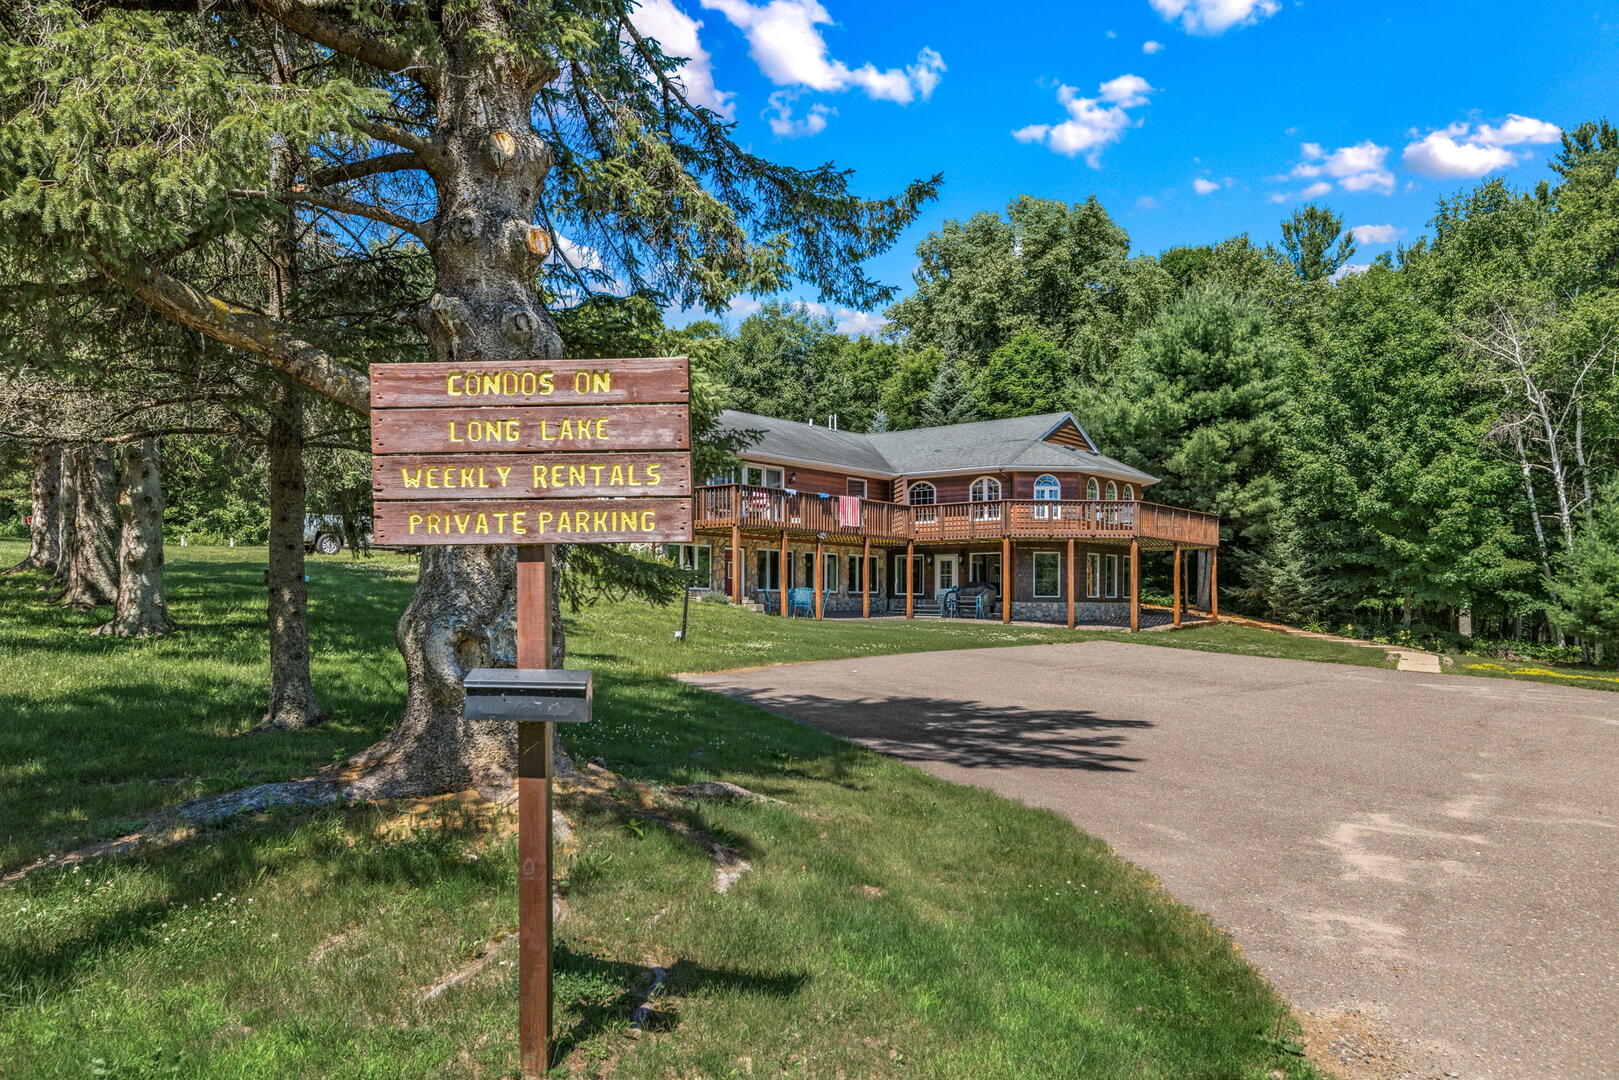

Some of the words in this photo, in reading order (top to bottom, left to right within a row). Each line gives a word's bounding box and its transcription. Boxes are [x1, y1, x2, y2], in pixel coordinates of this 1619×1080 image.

[446, 369, 556, 396] CONDOS
[573, 367, 613, 395] ON
[448, 418, 521, 441] LONG
[540, 416, 610, 440] LAKE
[401, 464, 513, 488] WEEKLY
[532, 463, 662, 488] RENTALS
[408, 510, 528, 535] PRIVATE
[537, 509, 657, 534] PARKING
